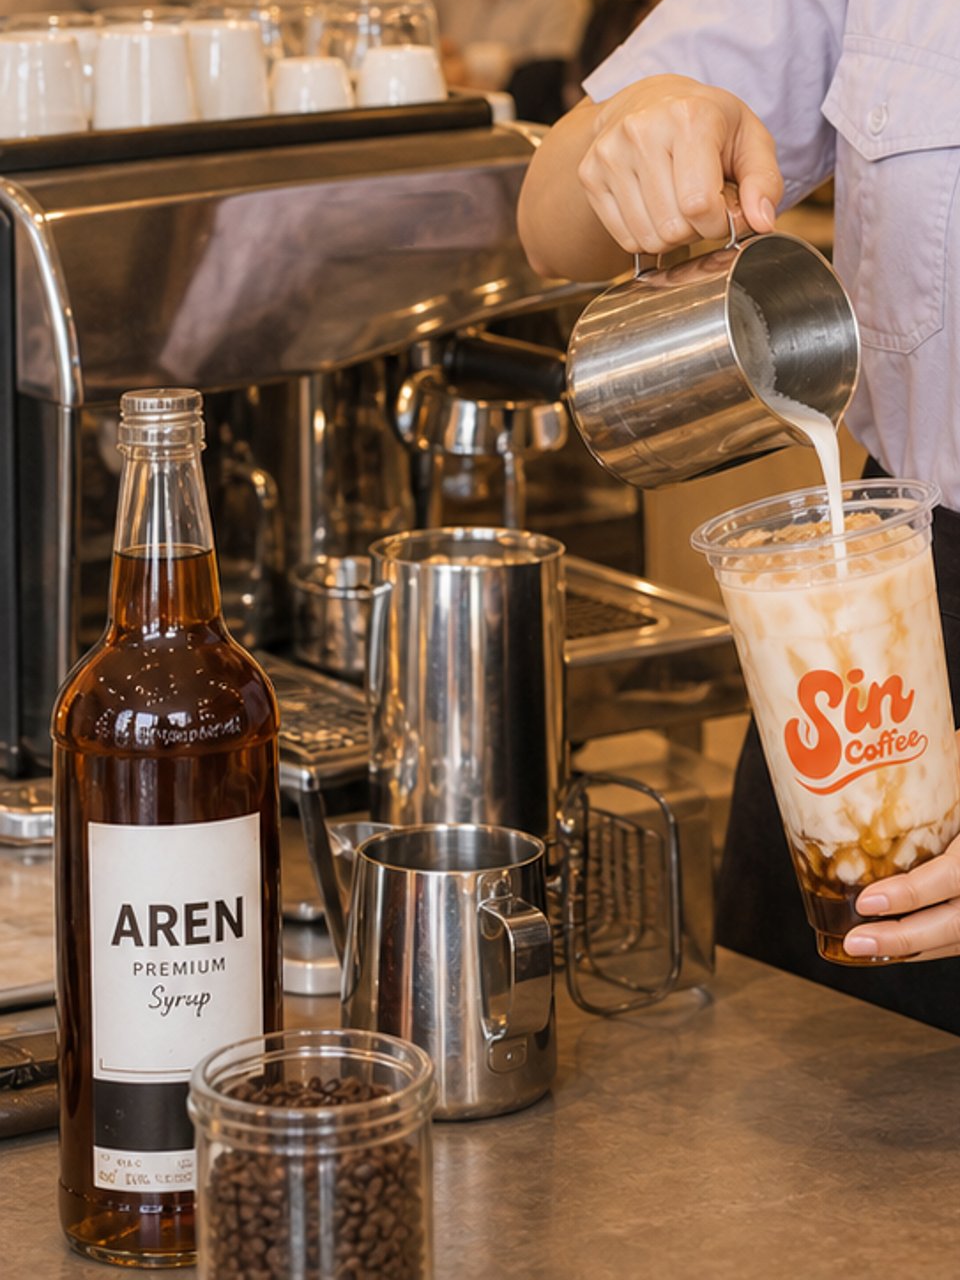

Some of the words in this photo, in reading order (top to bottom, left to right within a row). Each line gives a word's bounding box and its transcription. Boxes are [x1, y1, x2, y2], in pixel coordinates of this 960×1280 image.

[784, 668, 915, 780] Sin
[111, 896, 243, 947] AREN
[133, 957, 226, 977] PREMIUM
[148, 984, 212, 1017] Syrup
